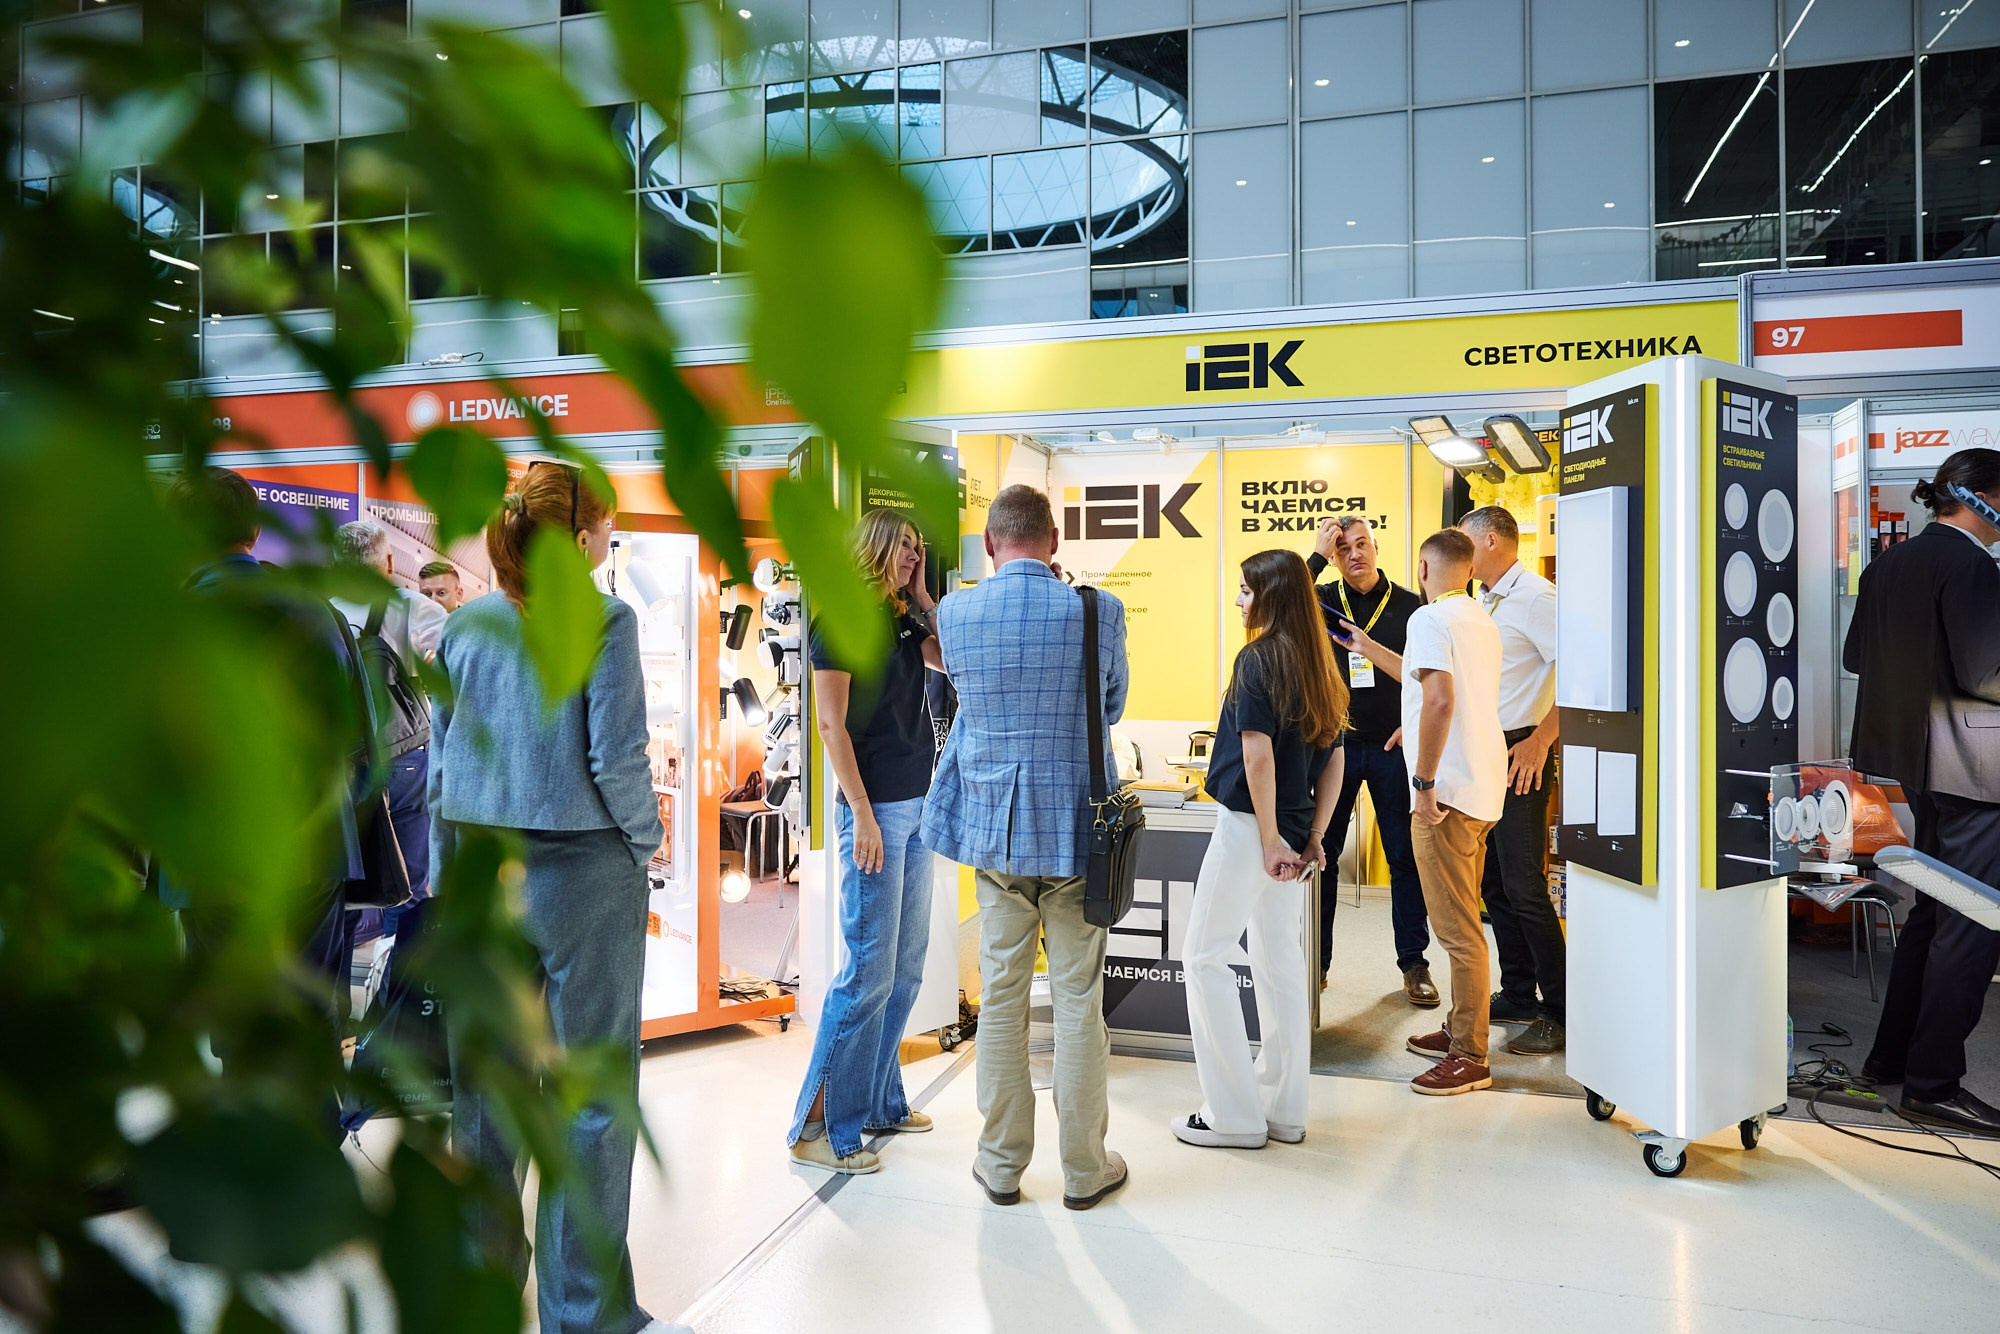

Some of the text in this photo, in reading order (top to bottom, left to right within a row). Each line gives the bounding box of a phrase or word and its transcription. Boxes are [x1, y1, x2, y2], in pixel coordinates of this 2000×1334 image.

[1771, 326, 1805, 348] 97
[1463, 335, 1703, 367] СВЕТОТЕХНИКА
[449, 394, 569, 422] LEDVANCE
[1722, 444, 1766, 460] ВСТРАИВАЕМЫЕ
[1563, 457, 1607, 474] СВЕТОДИОДНЫЕ
[1722, 457, 1762, 471] СВЕТИЛЬНИКИ
[1241, 479, 1329, 496] ВКЛЮ
[1563, 473, 1585, 485] ПАНЕЛИ
[270, 489, 350, 512] ОСВЕЩЕНИЕ
[868, 497, 915, 509] СВЕТИЛЬНИКИ
[1241, 497, 1366, 514] ЧАЕМСЯ
[370, 505, 440, 525] ПРОМЫШЛЕ
[1242, 518, 1260, 532] В
[1081, 570, 1152, 579] Промышленное
[1081, 580, 1131, 588] освещение
[1103, 965, 1171, 982] ЧАЕМСЯ
